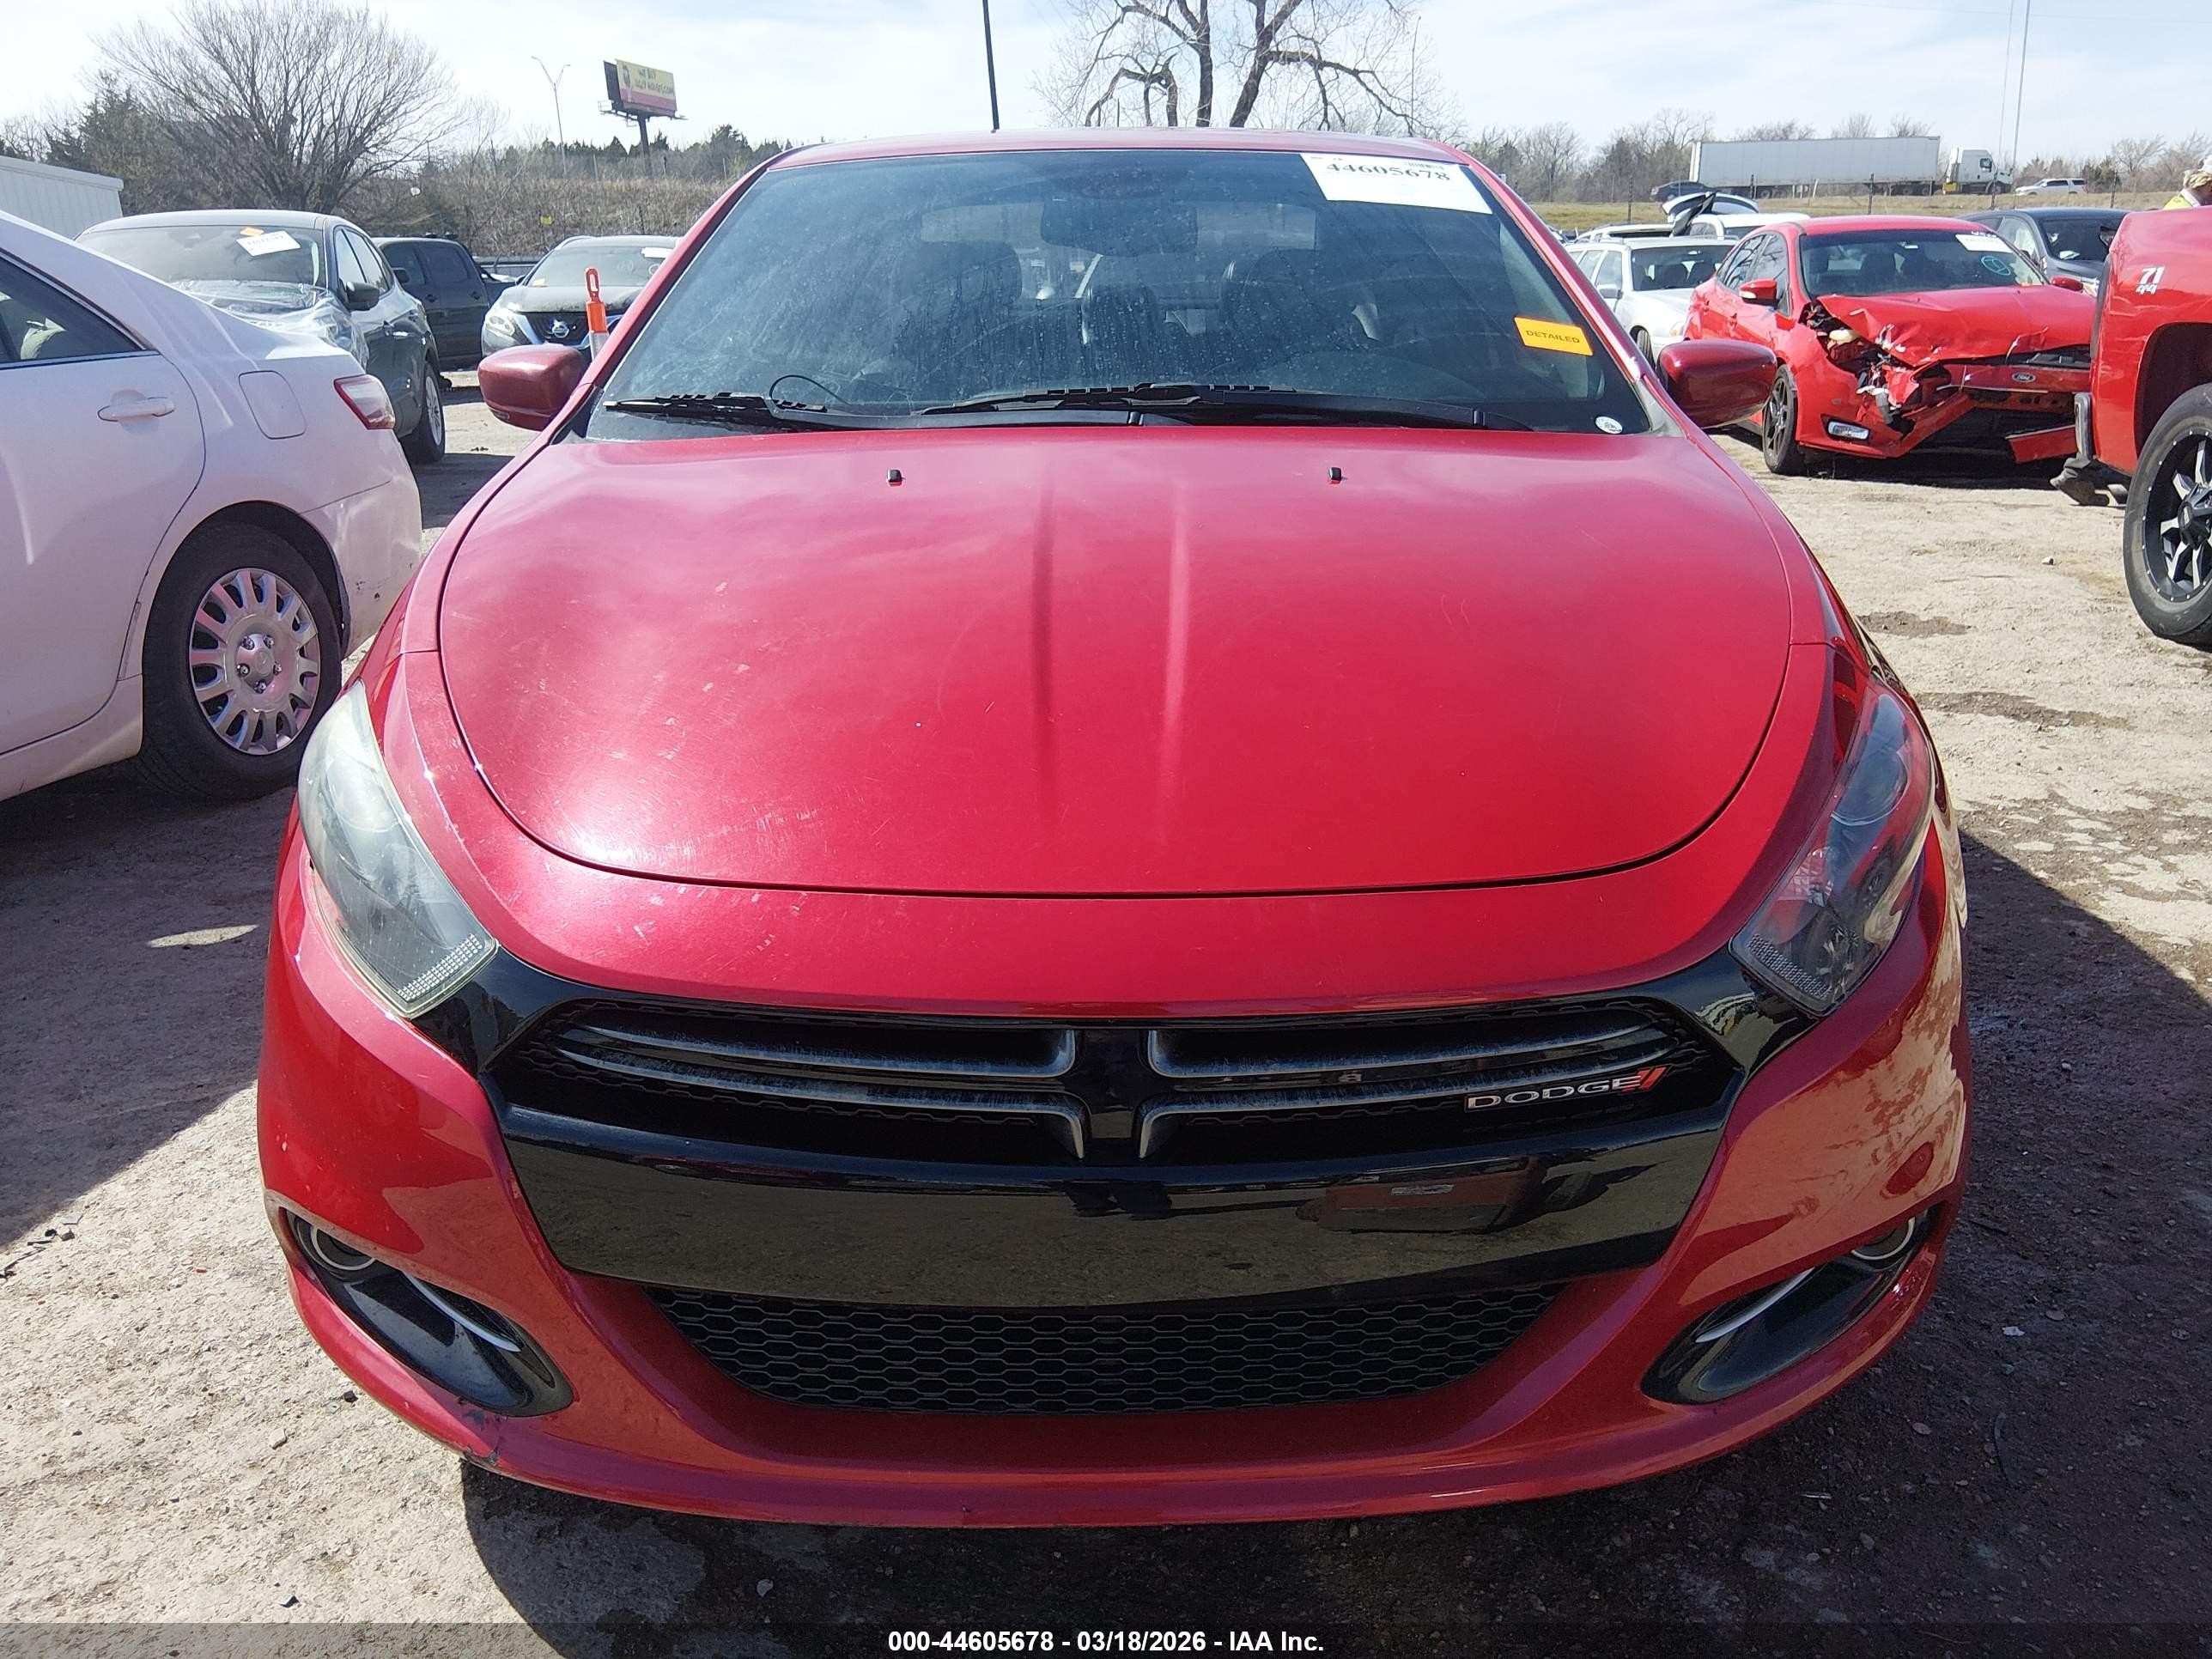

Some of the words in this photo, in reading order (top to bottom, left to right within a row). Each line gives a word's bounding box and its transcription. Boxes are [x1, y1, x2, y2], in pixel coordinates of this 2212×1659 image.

[1327, 163, 1450, 180] 44605678
[1525, 330, 1580, 343] DETAILED
[1468, 1075, 1642, 1109] DODGE
